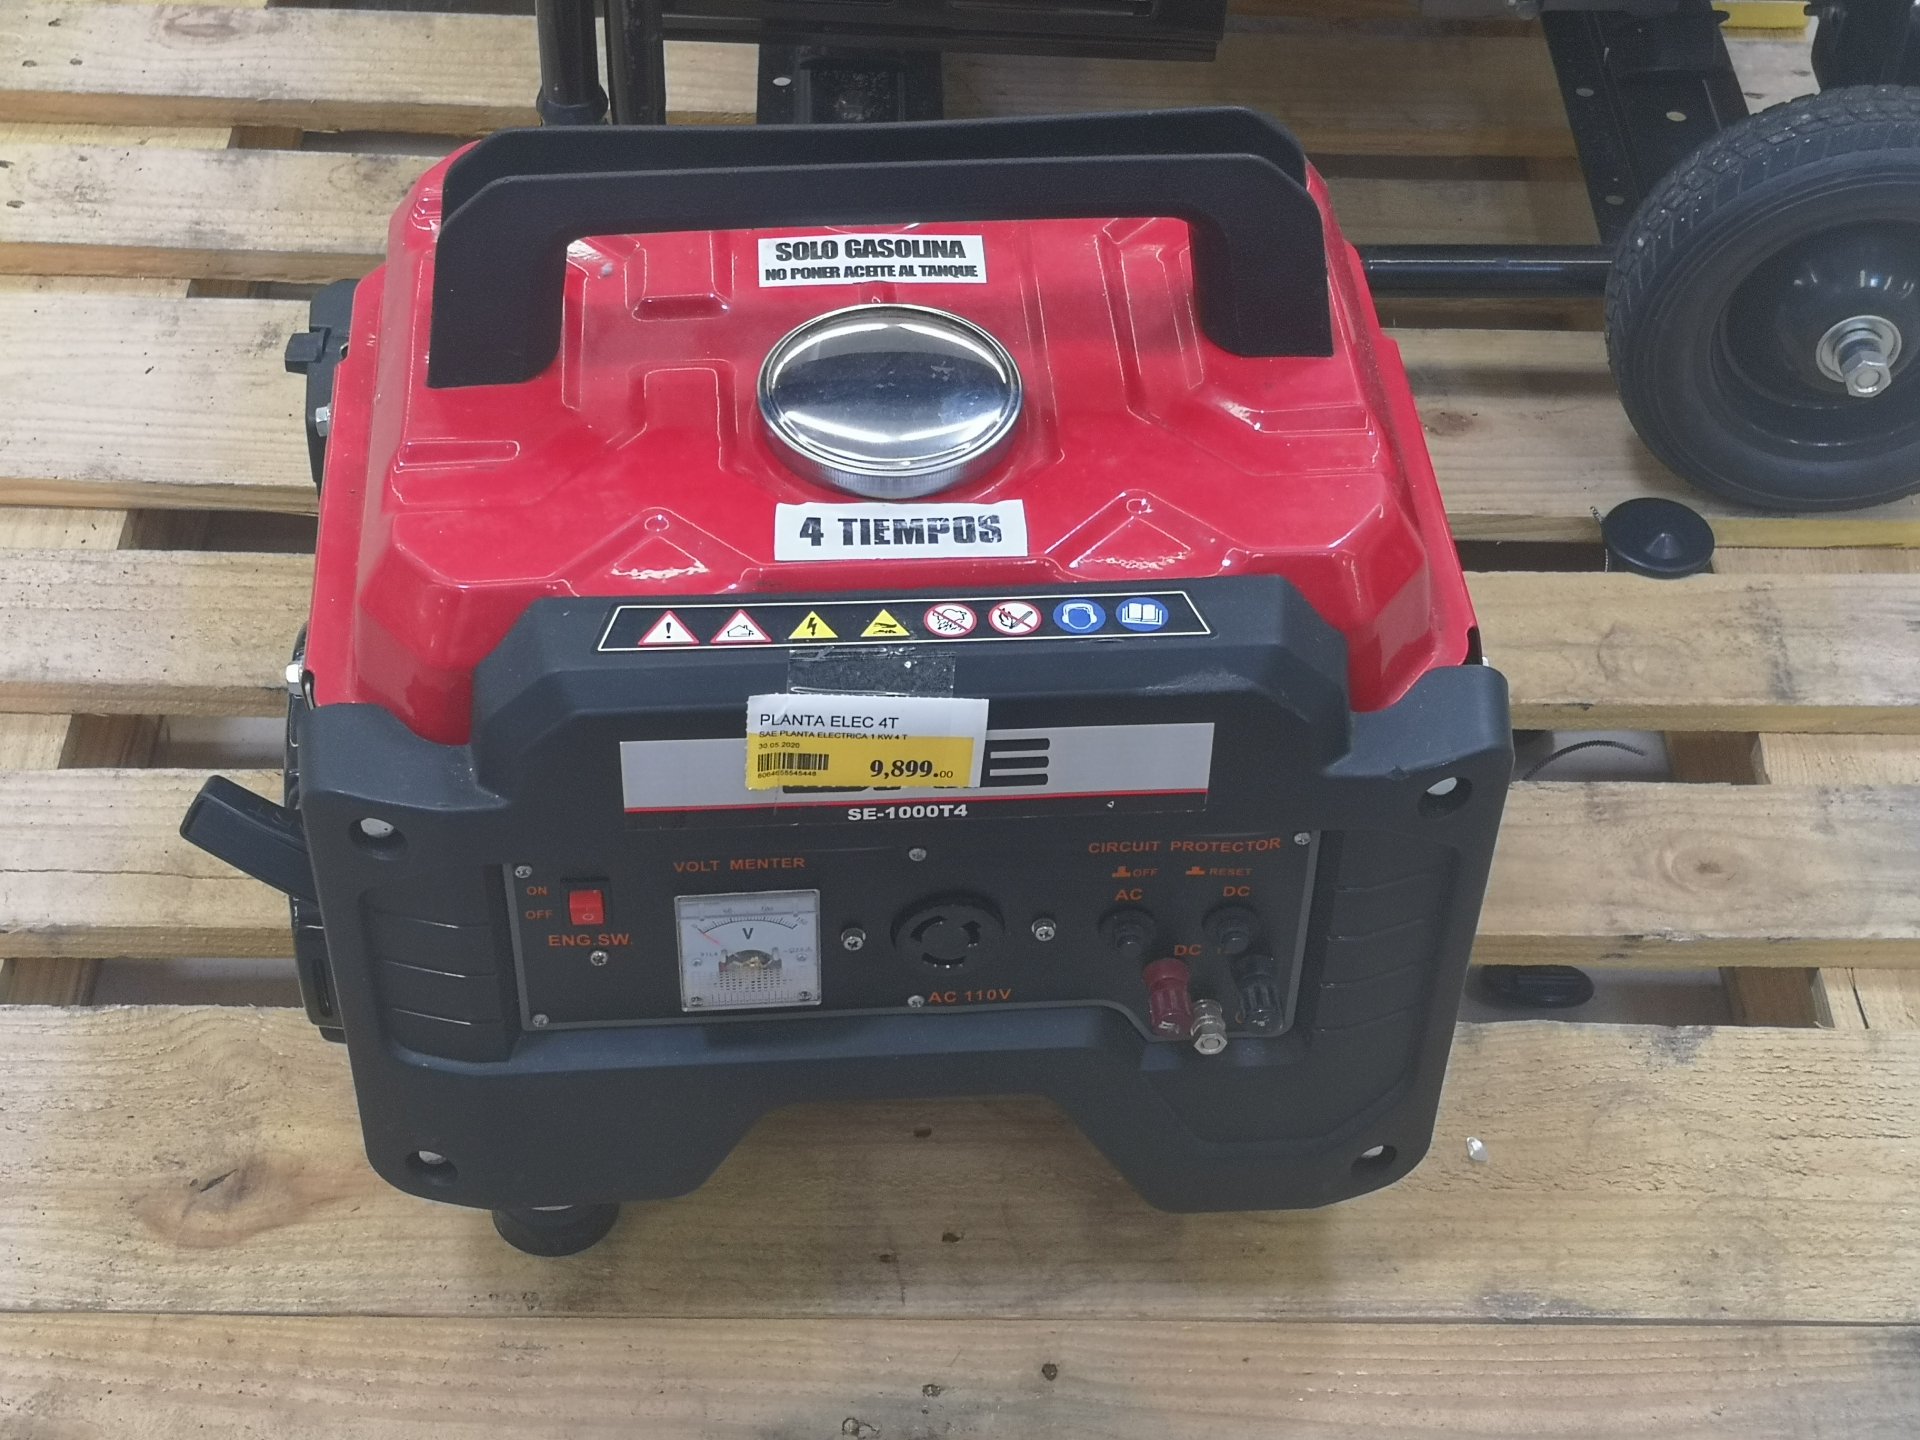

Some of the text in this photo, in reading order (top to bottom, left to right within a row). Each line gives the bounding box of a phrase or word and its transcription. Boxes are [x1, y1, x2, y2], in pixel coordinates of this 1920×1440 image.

[775, 239, 967, 261] SOLO GASOLINA
[765, 264, 978, 281] NO PONER ACEITE AL TANQUE
[799, 514, 1002, 546] 4 TIEMPOS
[760, 713, 899, 729] PLANTA ELEC 4T
[759, 730, 777, 738] SAE
[779, 730, 814, 738] PLANTA
[817, 731, 868, 740] ELECTRICA
[869, 759, 954, 779] 9,899.00
[848, 804, 968, 821] SE-1000T4
[1088, 837, 1281, 854] CIRCUIT PROTECTOR
[673, 857, 806, 873] VOLT MENTER
[1209, 867, 1254, 877] RESET
[1132, 867, 1159, 878] OFF
[526, 886, 548, 896] ON
[1115, 888, 1144, 901] AC
[1222, 885, 1251, 897] DC
[525, 909, 553, 920] OFF
[742, 927, 754, 940] V
[1173, 944, 1202, 956] DC
[928, 988, 1012, 1003] AC 110V
